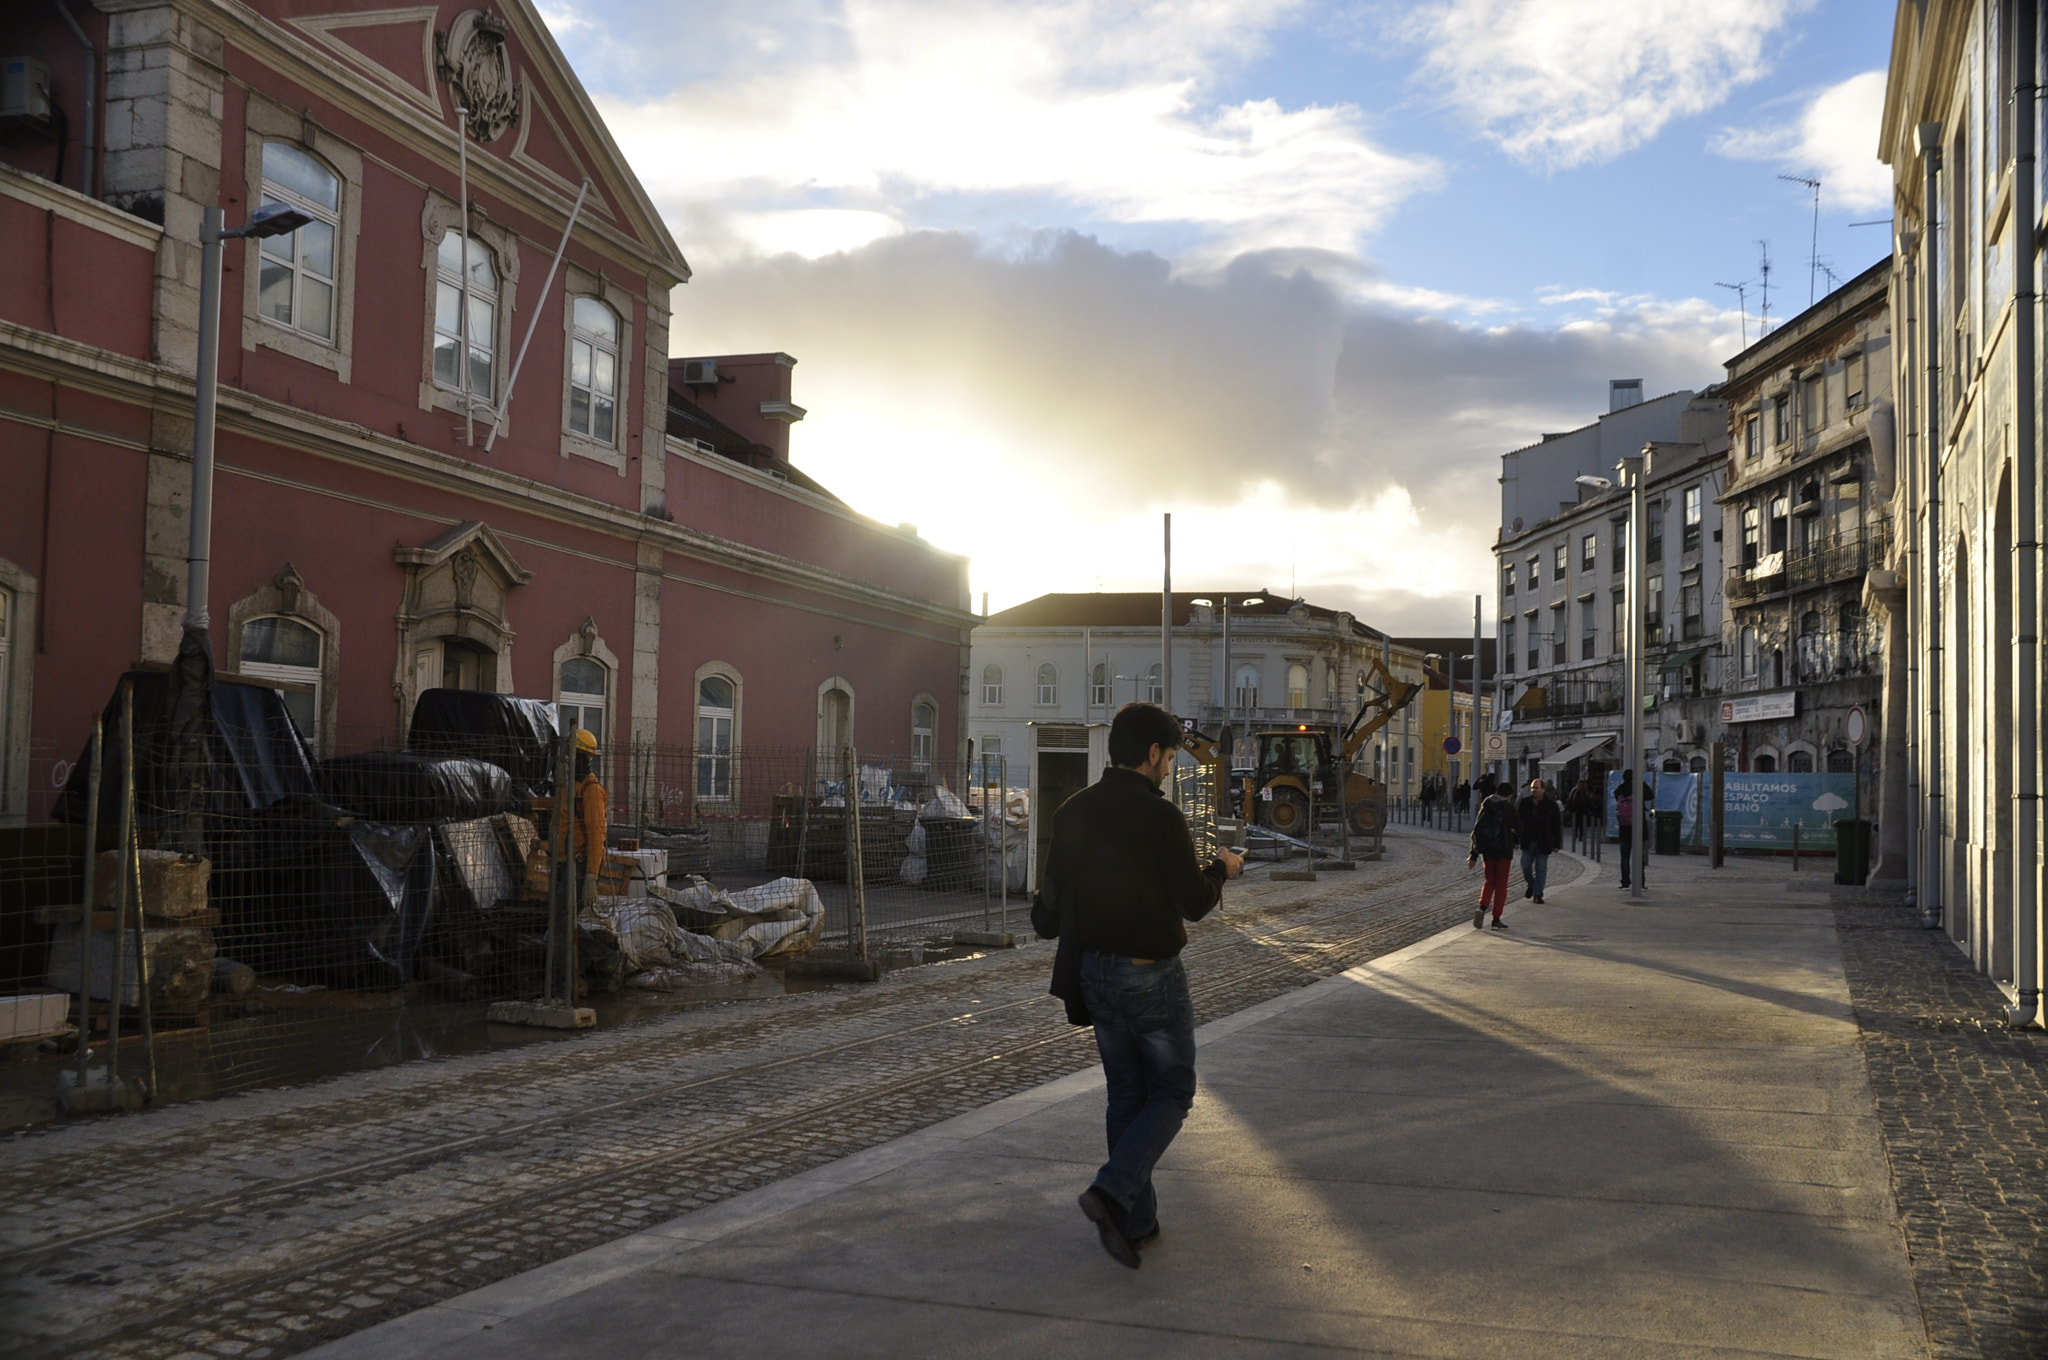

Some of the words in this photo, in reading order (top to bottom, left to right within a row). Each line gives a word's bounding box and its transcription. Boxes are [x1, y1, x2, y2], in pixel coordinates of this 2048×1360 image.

[1185, 738, 1195, 748] CAT
[1724, 782, 1797, 793] ABILITAMOS
[1724, 802, 1760, 812] BANO
